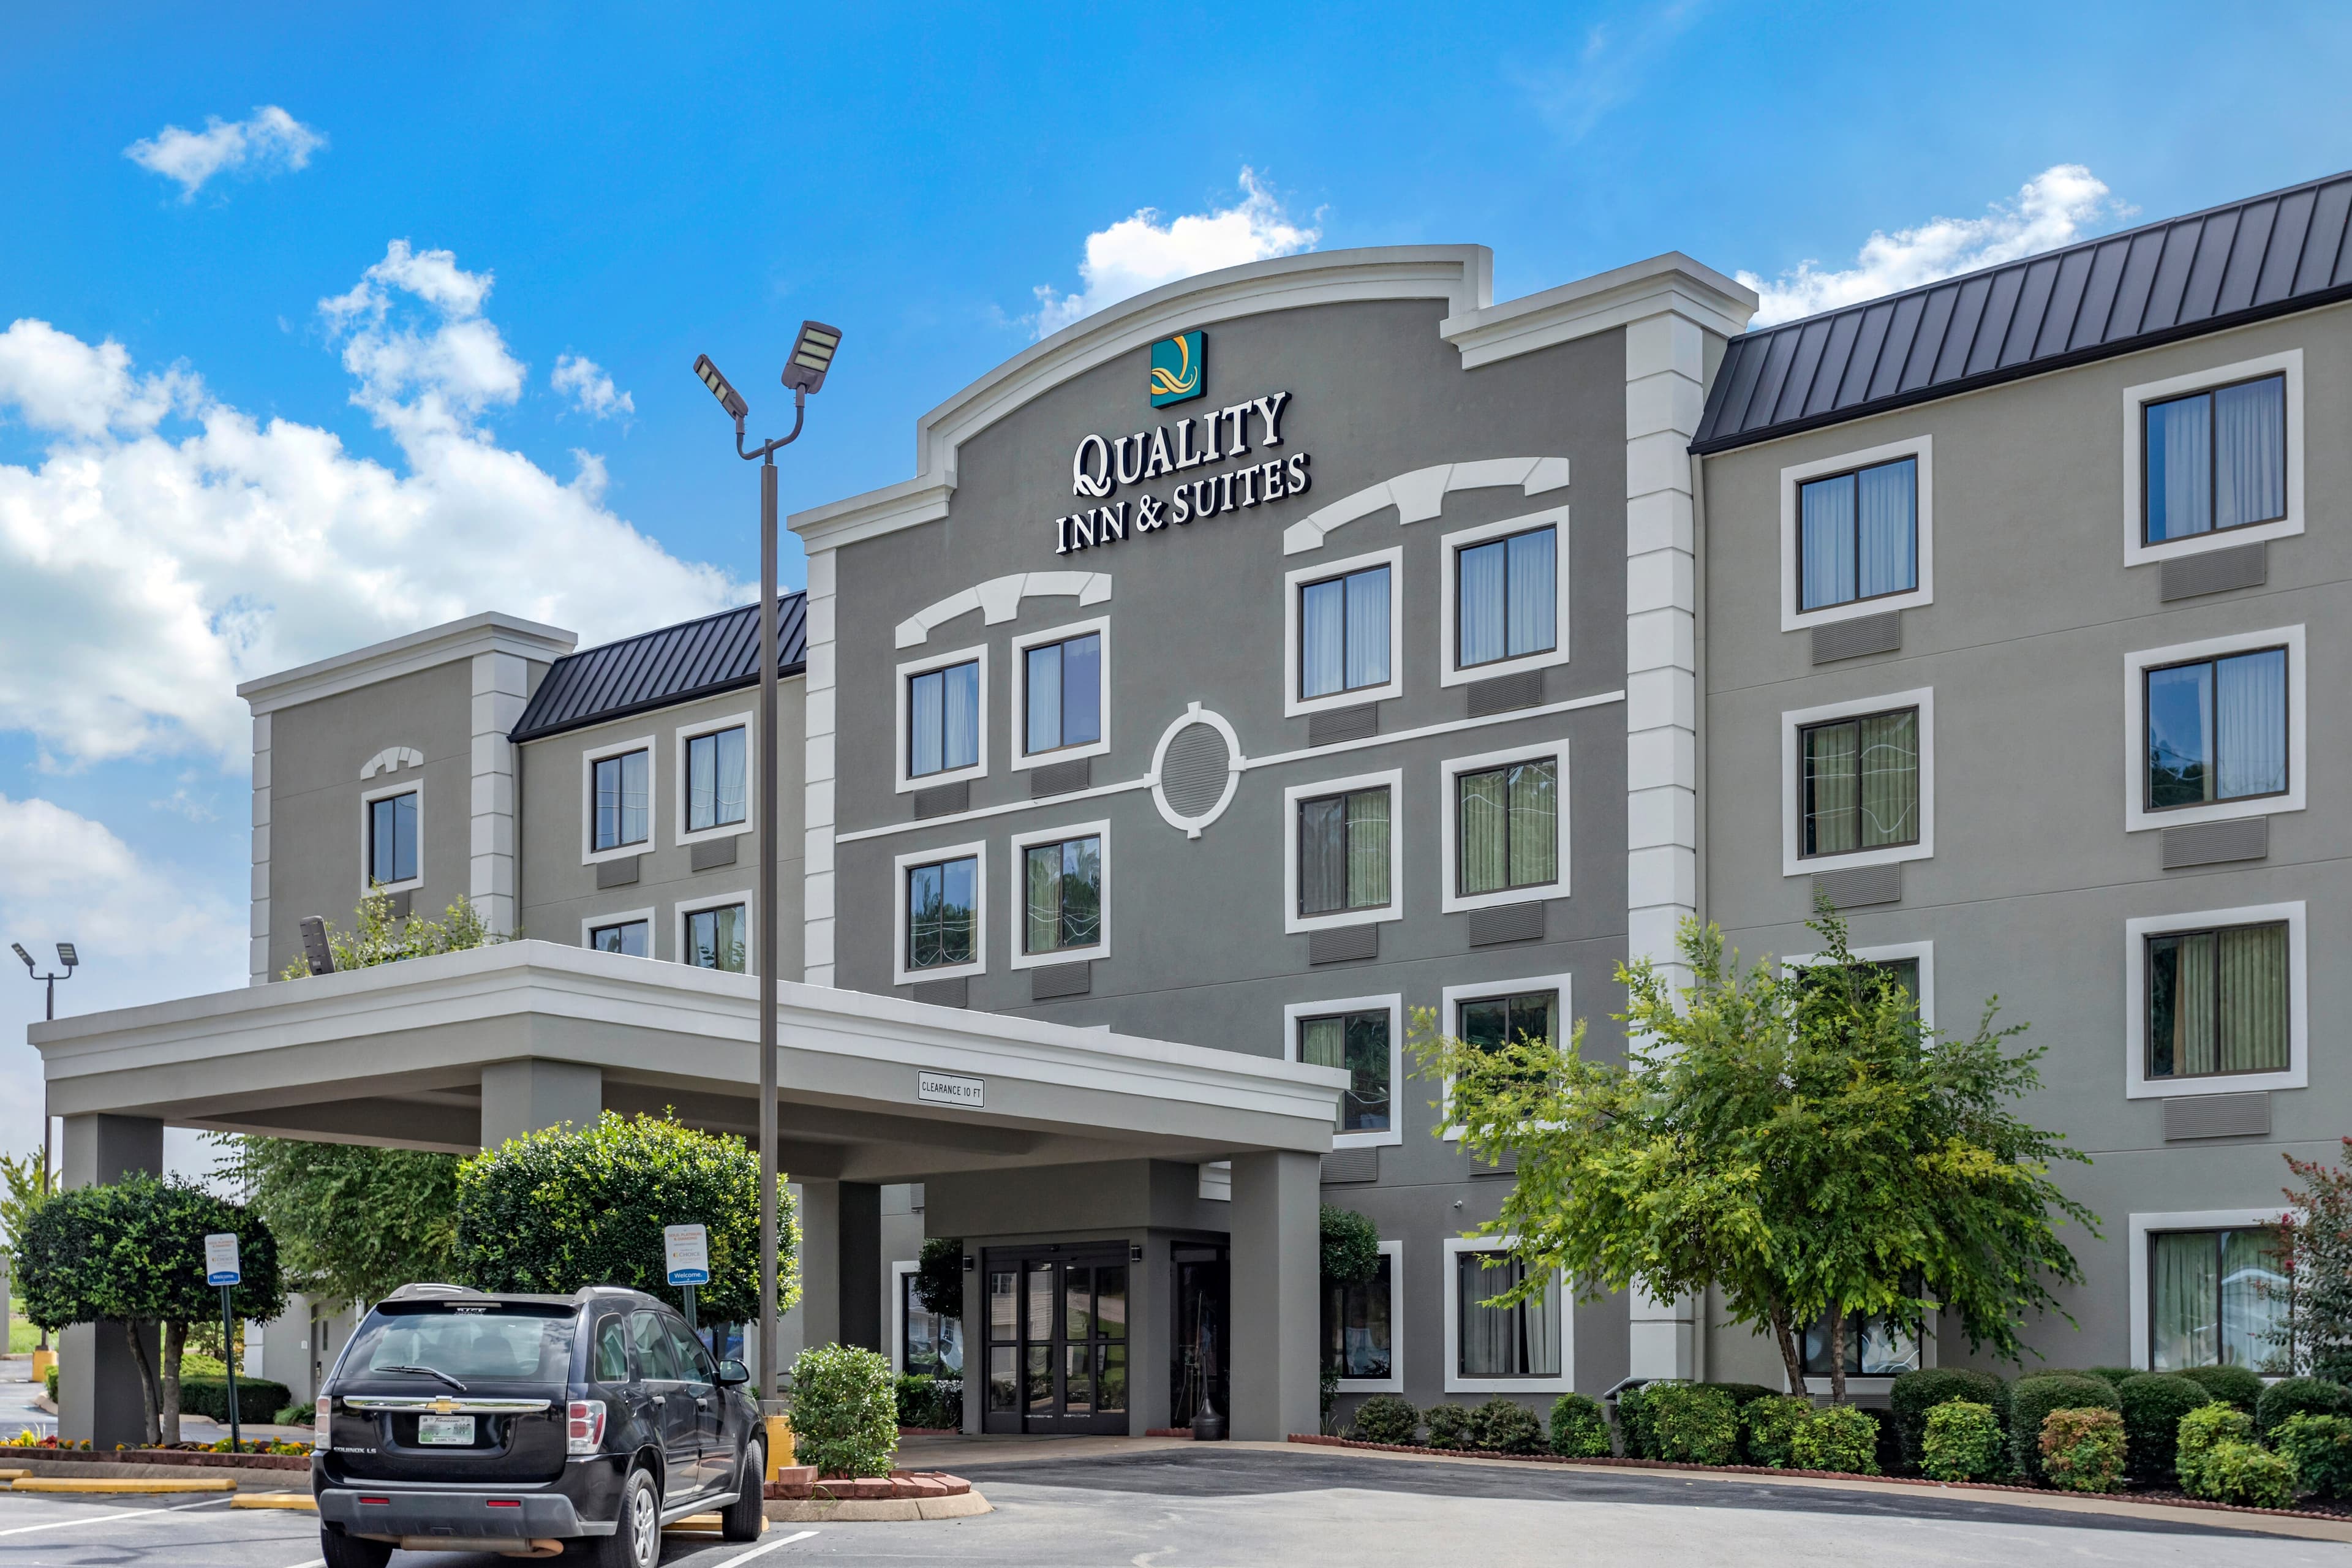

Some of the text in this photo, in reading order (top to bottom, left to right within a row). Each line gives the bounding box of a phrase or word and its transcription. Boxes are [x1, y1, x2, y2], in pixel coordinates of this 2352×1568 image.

[1073, 391, 1291, 497] QUALITY
[1055, 453, 1311, 554] INN & SUITES
[922, 1082, 981, 1098] CLEARANCE 10 FT
